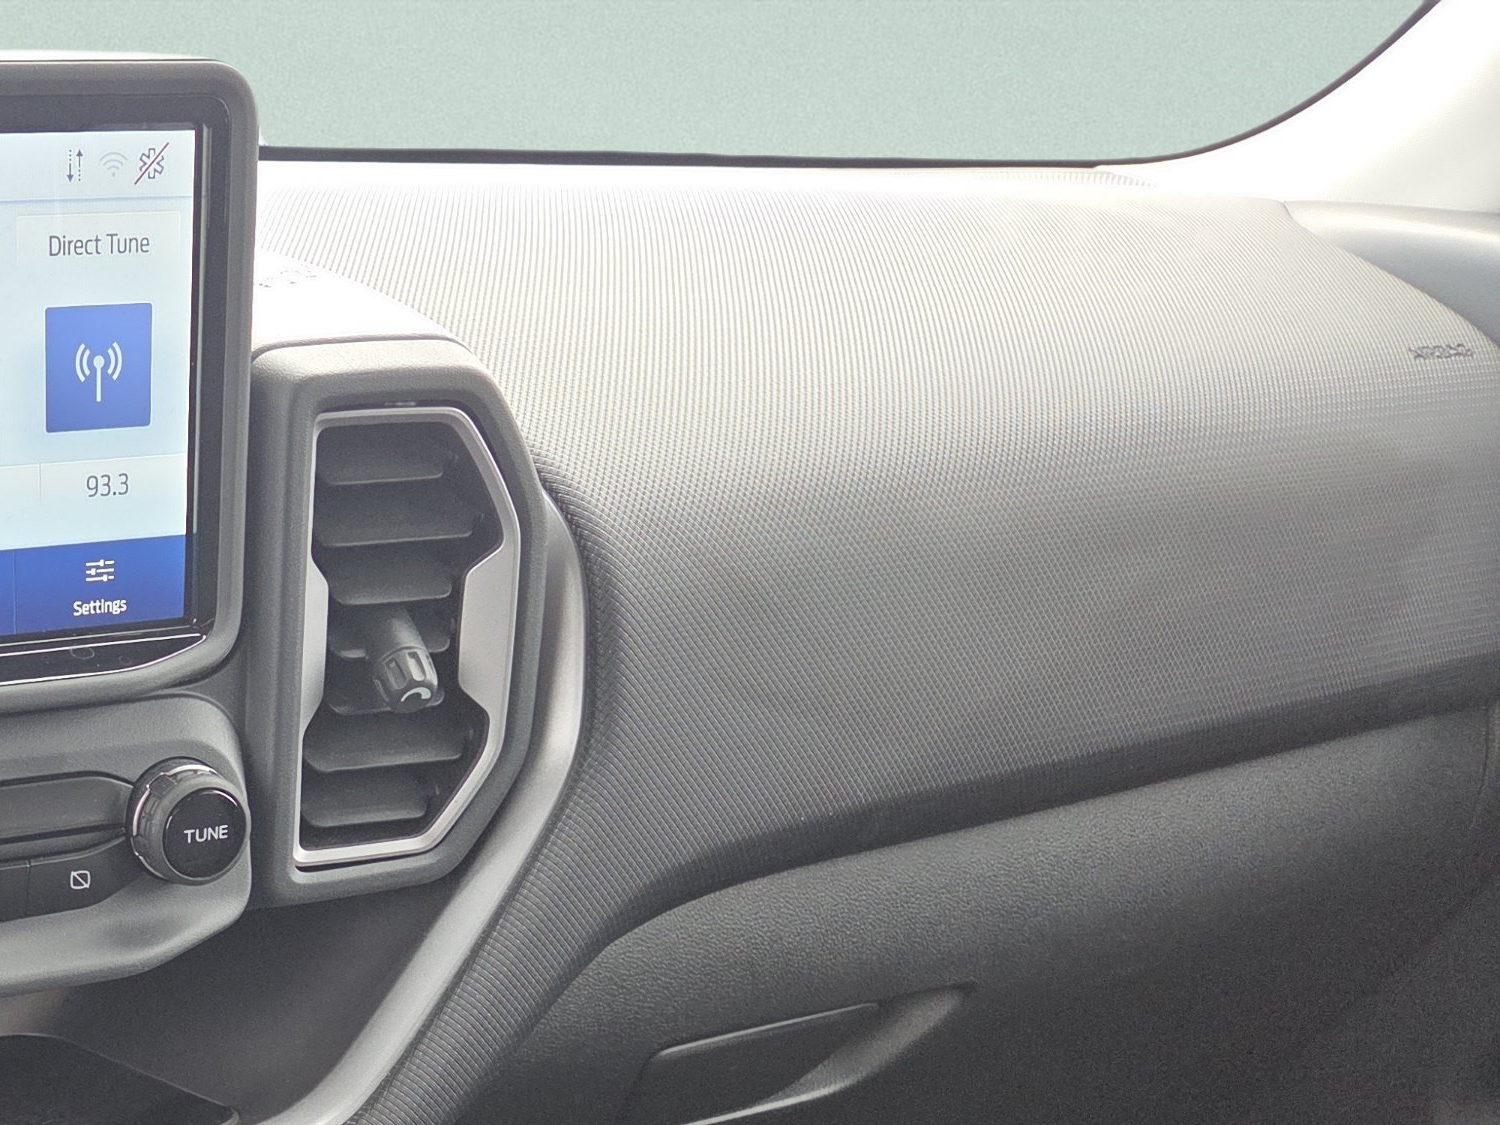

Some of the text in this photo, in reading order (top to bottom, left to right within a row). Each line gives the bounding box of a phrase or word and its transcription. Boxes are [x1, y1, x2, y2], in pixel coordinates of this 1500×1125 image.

[48, 234, 150, 257] Direct Tune
[85, 472, 130, 498] 93.3
[72, 597, 128, 617] Settings
[183, 824, 229, 844] TUNE
